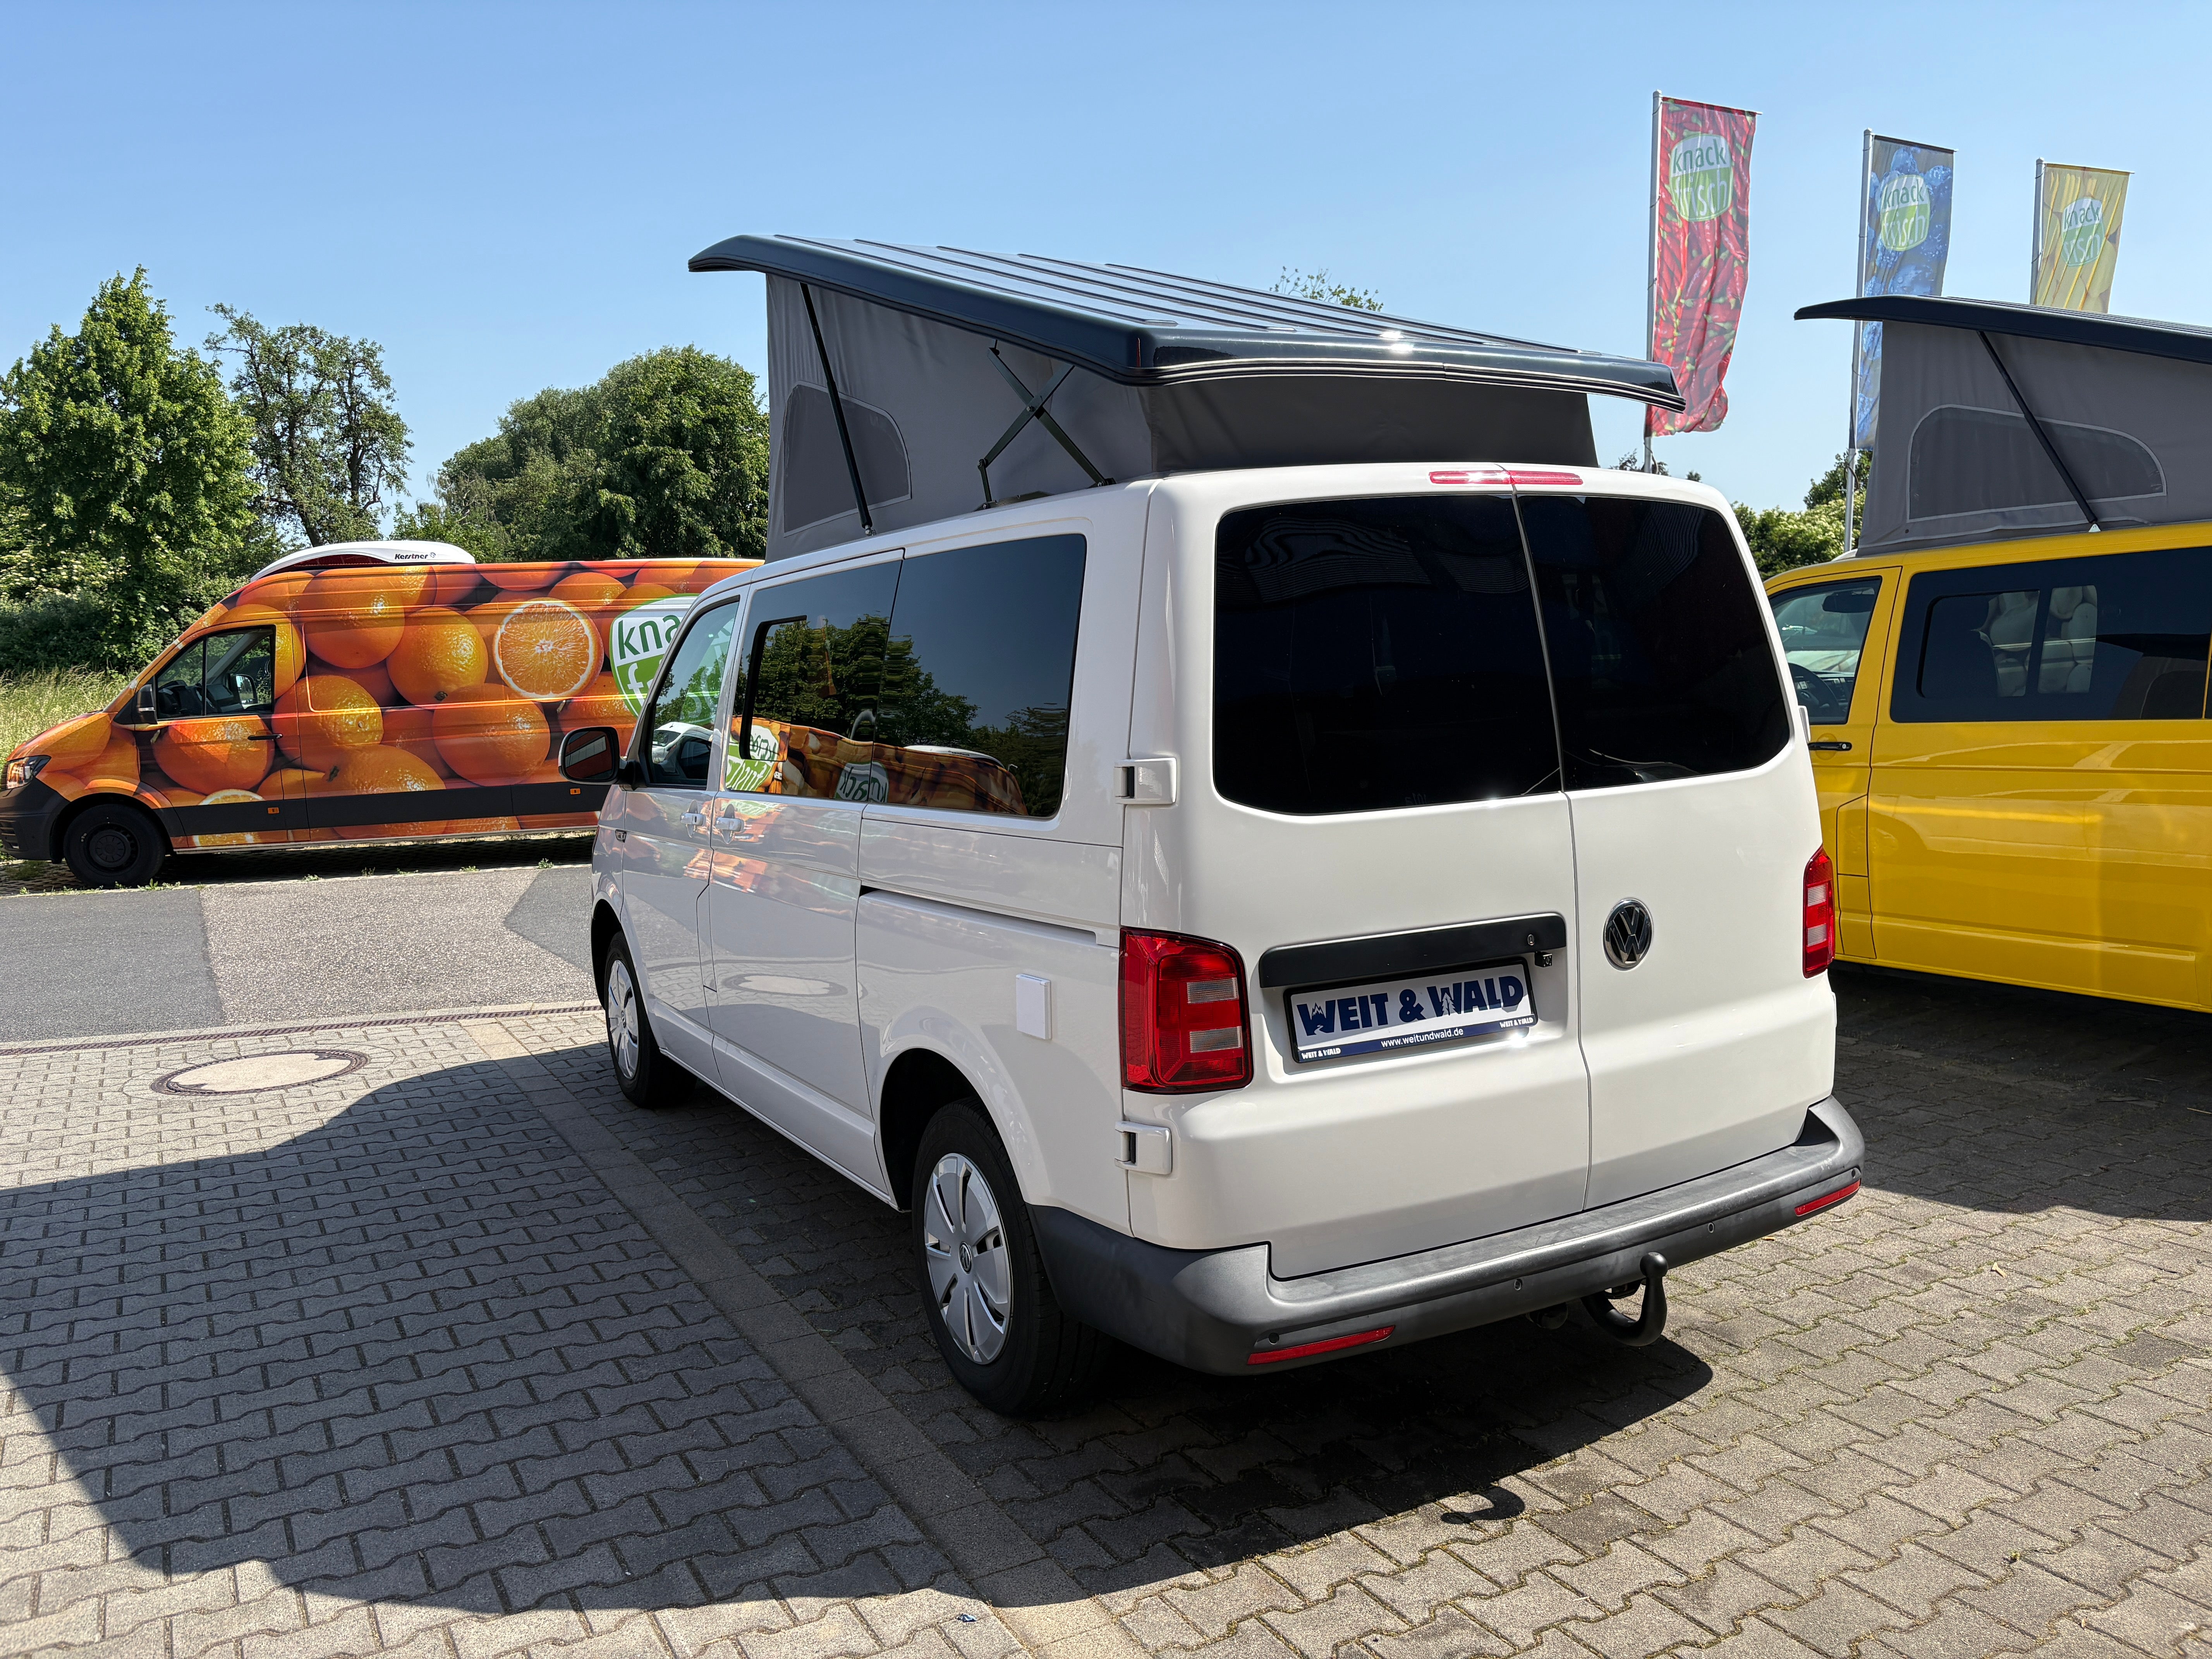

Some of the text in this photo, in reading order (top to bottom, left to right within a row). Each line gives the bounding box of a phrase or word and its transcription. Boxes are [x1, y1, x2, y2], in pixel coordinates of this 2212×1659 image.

[1673, 139, 1727, 174] knack
[1674, 167, 1728, 216] frisch
[1884, 179, 1924, 209] knack
[2064, 201, 2100, 230] knack
[618, 615, 681, 659] kna
[1297, 976, 1523, 1036] WEIT & WALD
[1518, 1017, 1534, 1025] WALD
[1381, 1027, 1464, 1048] www.weitundwald.de
[1302, 1051, 1317, 1060] WEIT
[1323, 1048, 1341, 1056] WALD
